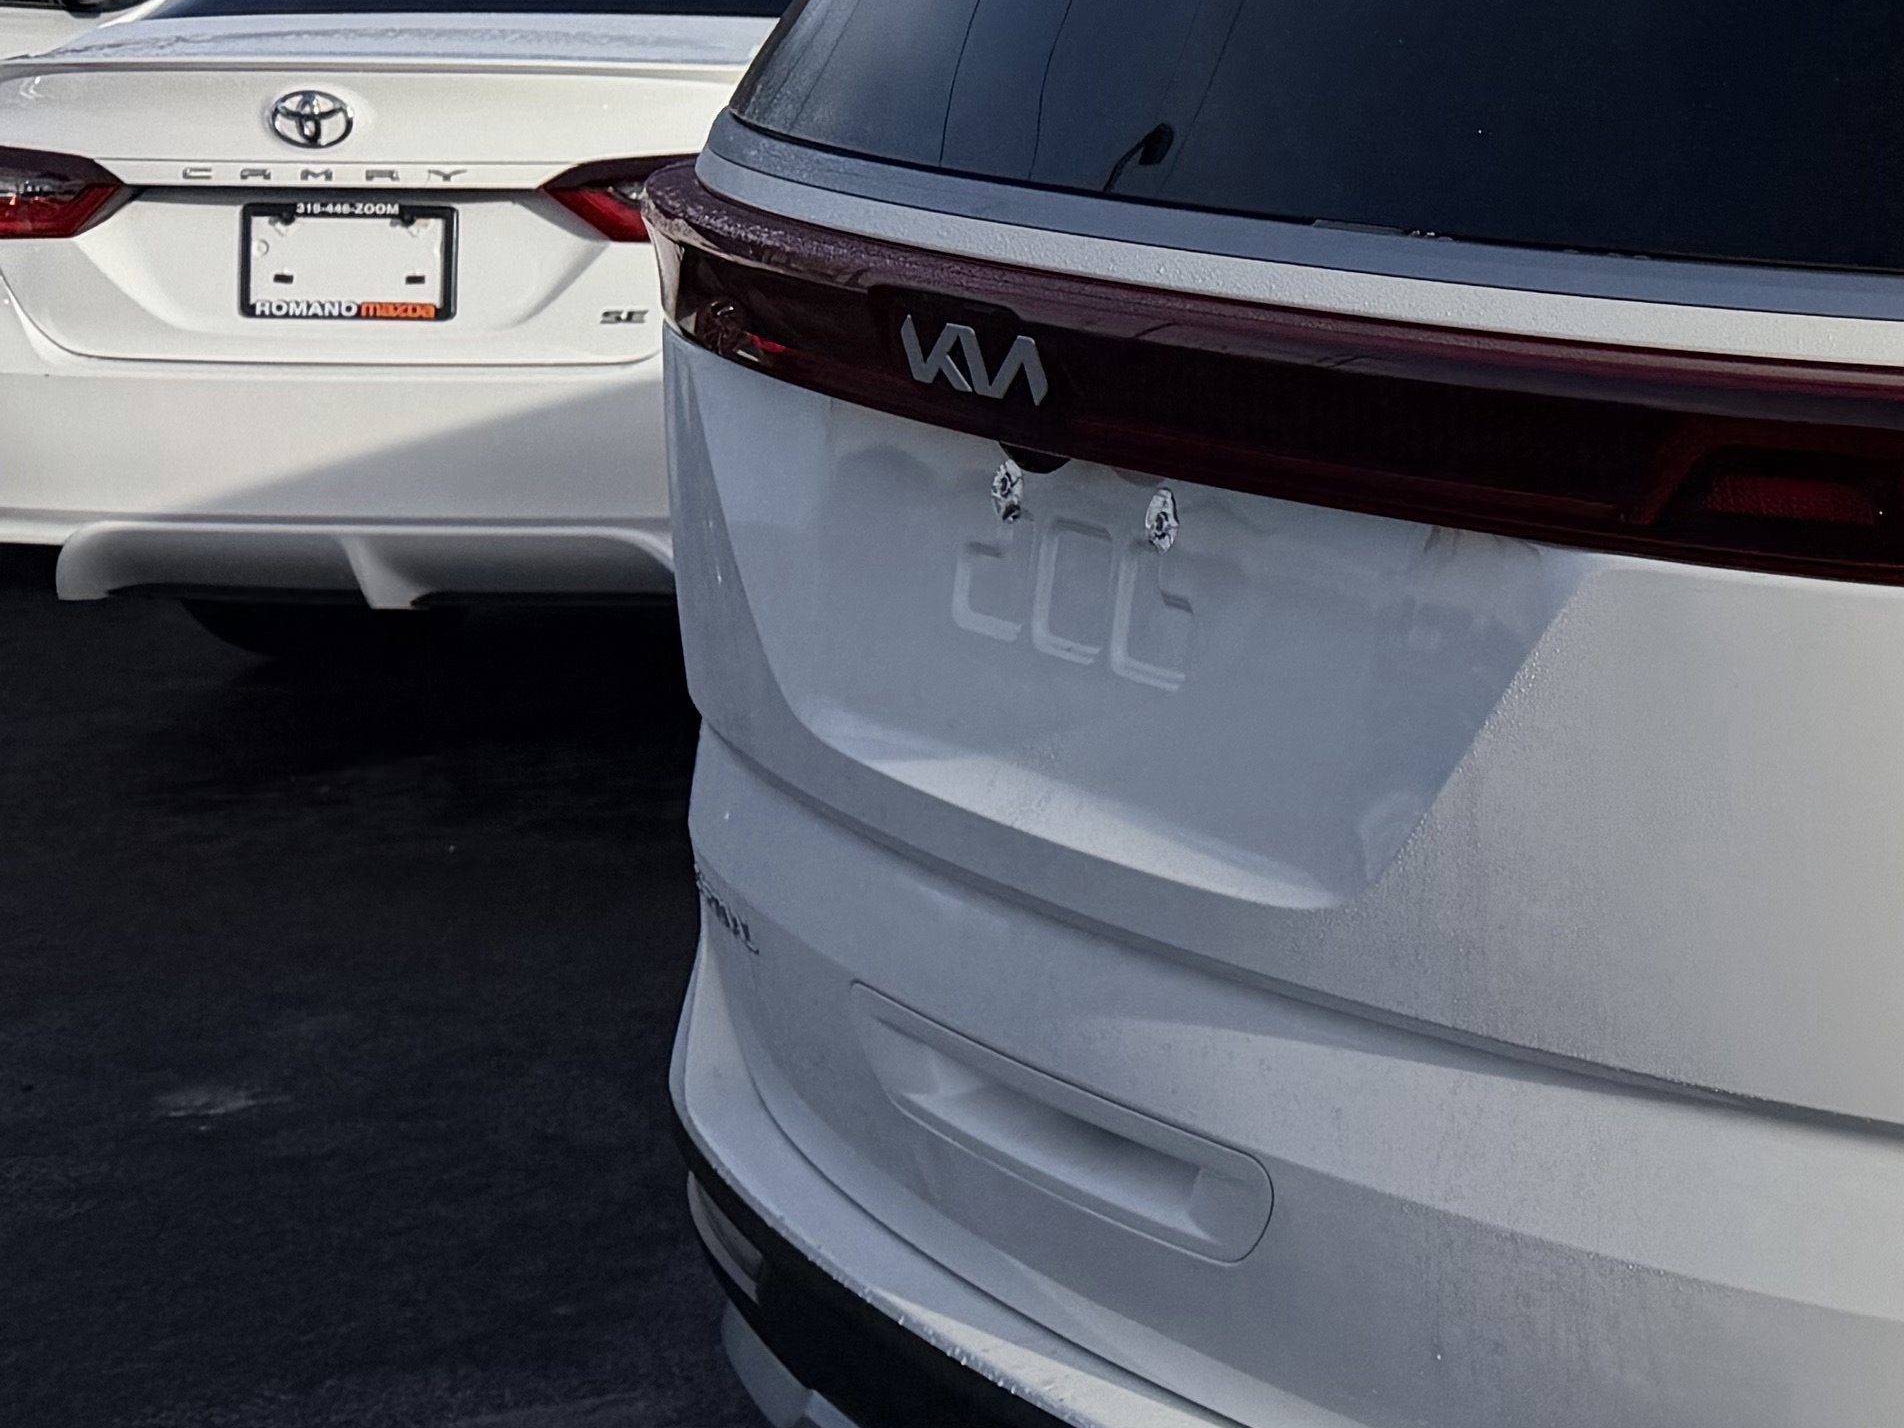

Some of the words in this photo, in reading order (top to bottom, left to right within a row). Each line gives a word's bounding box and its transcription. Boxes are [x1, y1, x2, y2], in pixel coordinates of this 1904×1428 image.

[182, 167, 468, 182] CAMRY
[254, 300, 358, 318] ROMANO
[600, 310, 649, 324] SE
[901, 314, 1049, 406] KIA
